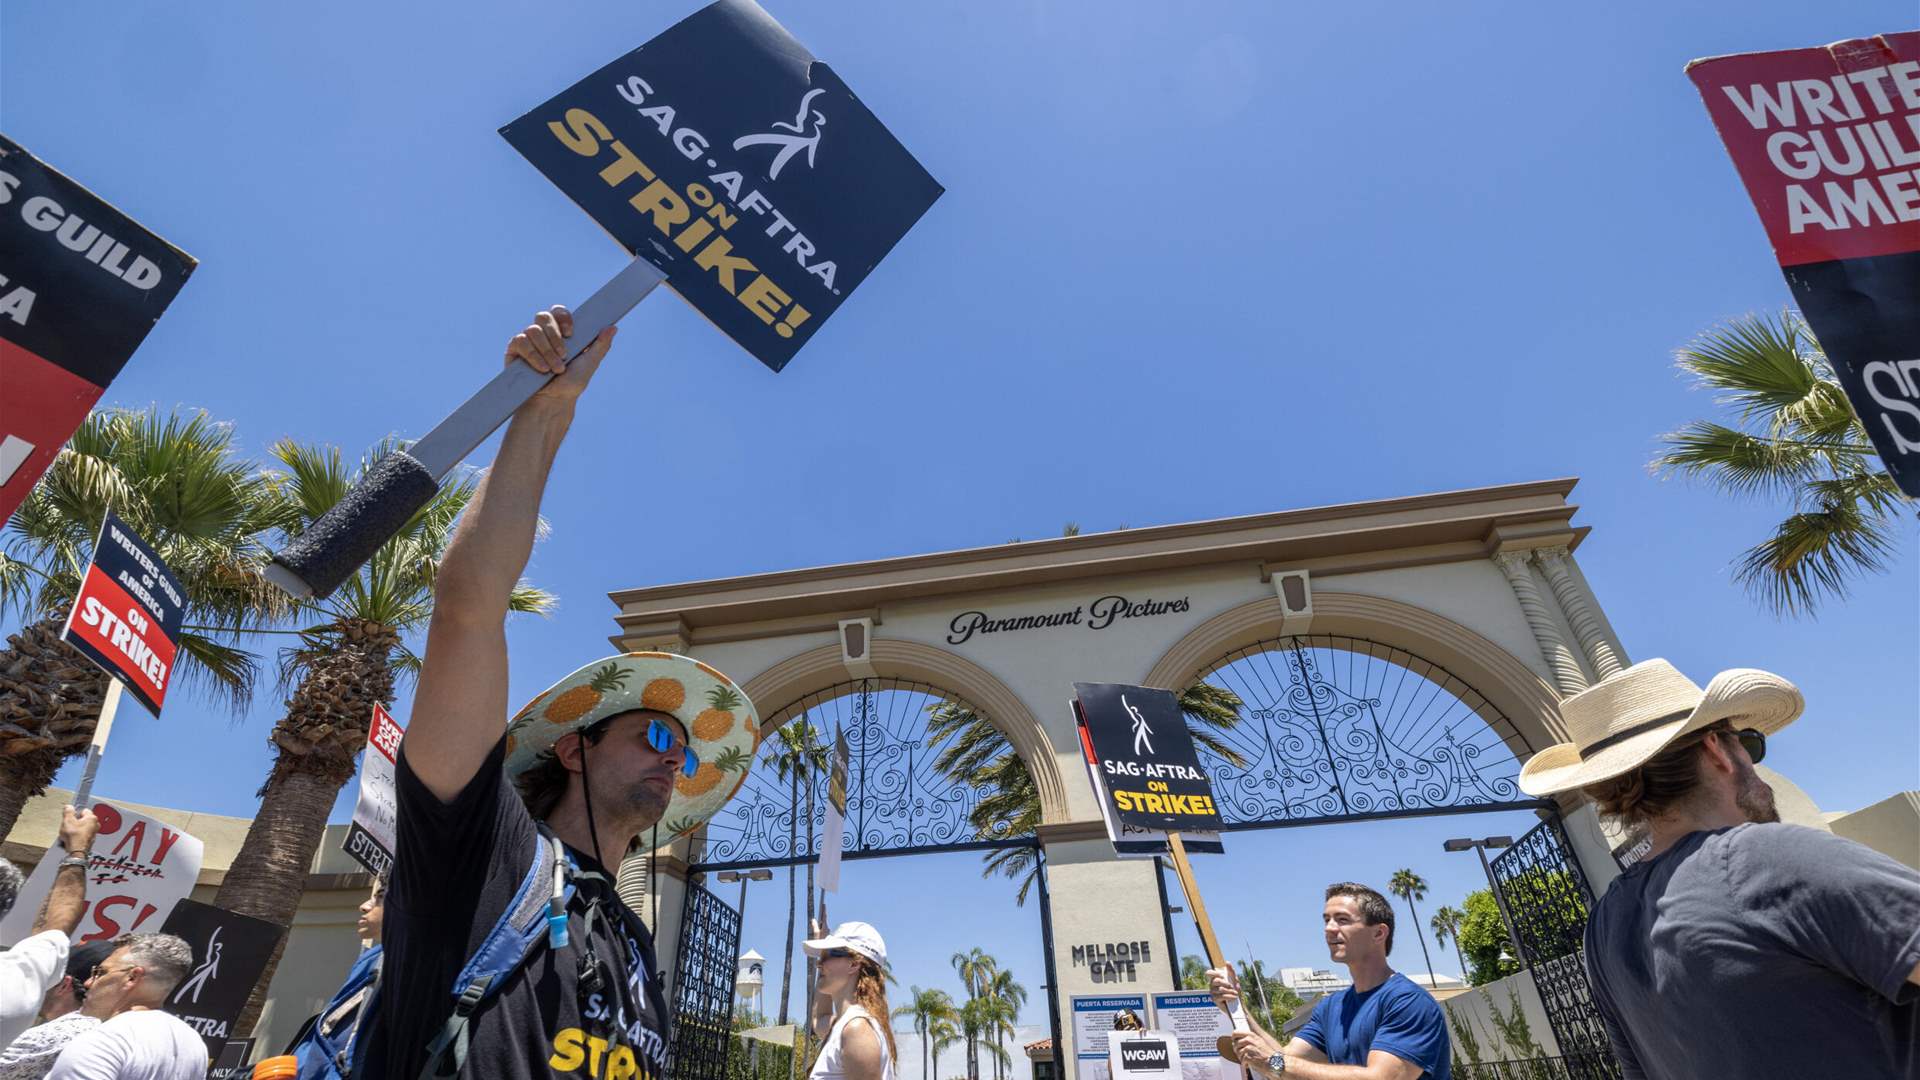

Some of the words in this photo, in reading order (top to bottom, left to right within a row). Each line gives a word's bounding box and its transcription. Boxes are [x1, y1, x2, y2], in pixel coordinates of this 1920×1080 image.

[1721, 60, 1920, 130] WRITE
[1767, 114, 1920, 180] GUIL
[547, 108, 811, 338] STRIKE!
[686, 183, 741, 231] ON
[1786, 169, 1920, 234] AME
[21, 196, 162, 290] GUILD
[111, 524, 160, 579] WRITERS
[158, 575, 182, 609] GUILD
[142, 574, 155, 590] OF
[118, 570, 165, 622] AMERICA
[947, 606, 1082, 645] Paramount
[1087, 595, 1190, 630] Pictures
[80, 596, 168, 691] STRIKE!
[127, 608, 149, 636] ON
[1114, 790, 1216, 816] STRIKE!
[1148, 781, 1169, 793] ON
[350, 830, 394, 873] STRI
[1072, 940, 1150, 962] MELROSE
[1090, 960, 1137, 976] GATE
[1164, 997, 1201, 1005] RESERVED
[1123, 1049, 1166, 1062] WGAW
